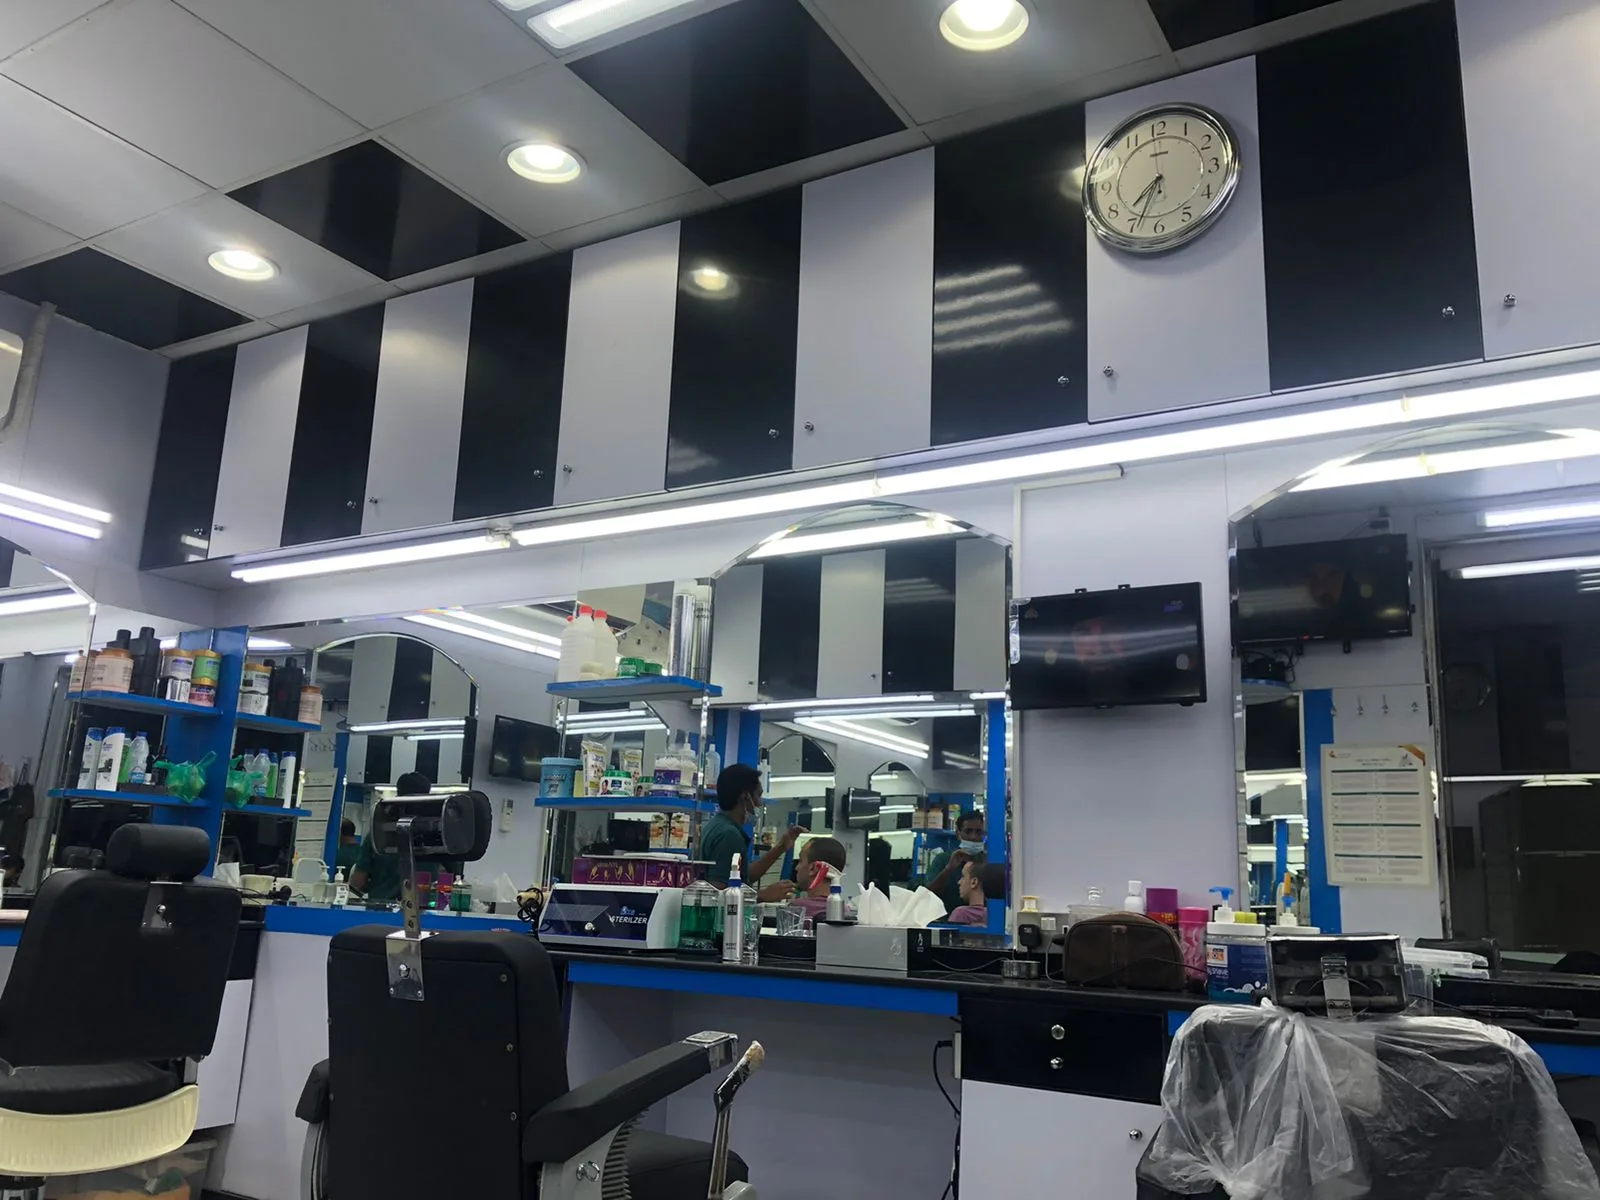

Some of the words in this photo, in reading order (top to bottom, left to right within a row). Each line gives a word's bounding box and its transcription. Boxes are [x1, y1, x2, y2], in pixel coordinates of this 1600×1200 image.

[1151, 120, 1166, 137] 12
[1183, 121, 1188, 137] 1
[1126, 134, 1138, 149] 11
[1201, 134, 1212, 151] 2
[1208, 157, 1220, 174] 3
[1101, 181, 1112, 196] 9
[1201, 183, 1212, 199] 4
[1107, 204, 1119, 219] 8
[1181, 206, 1192, 223] 5
[1127, 218, 1138, 233] 7
[1153, 219, 1165, 234] 6
